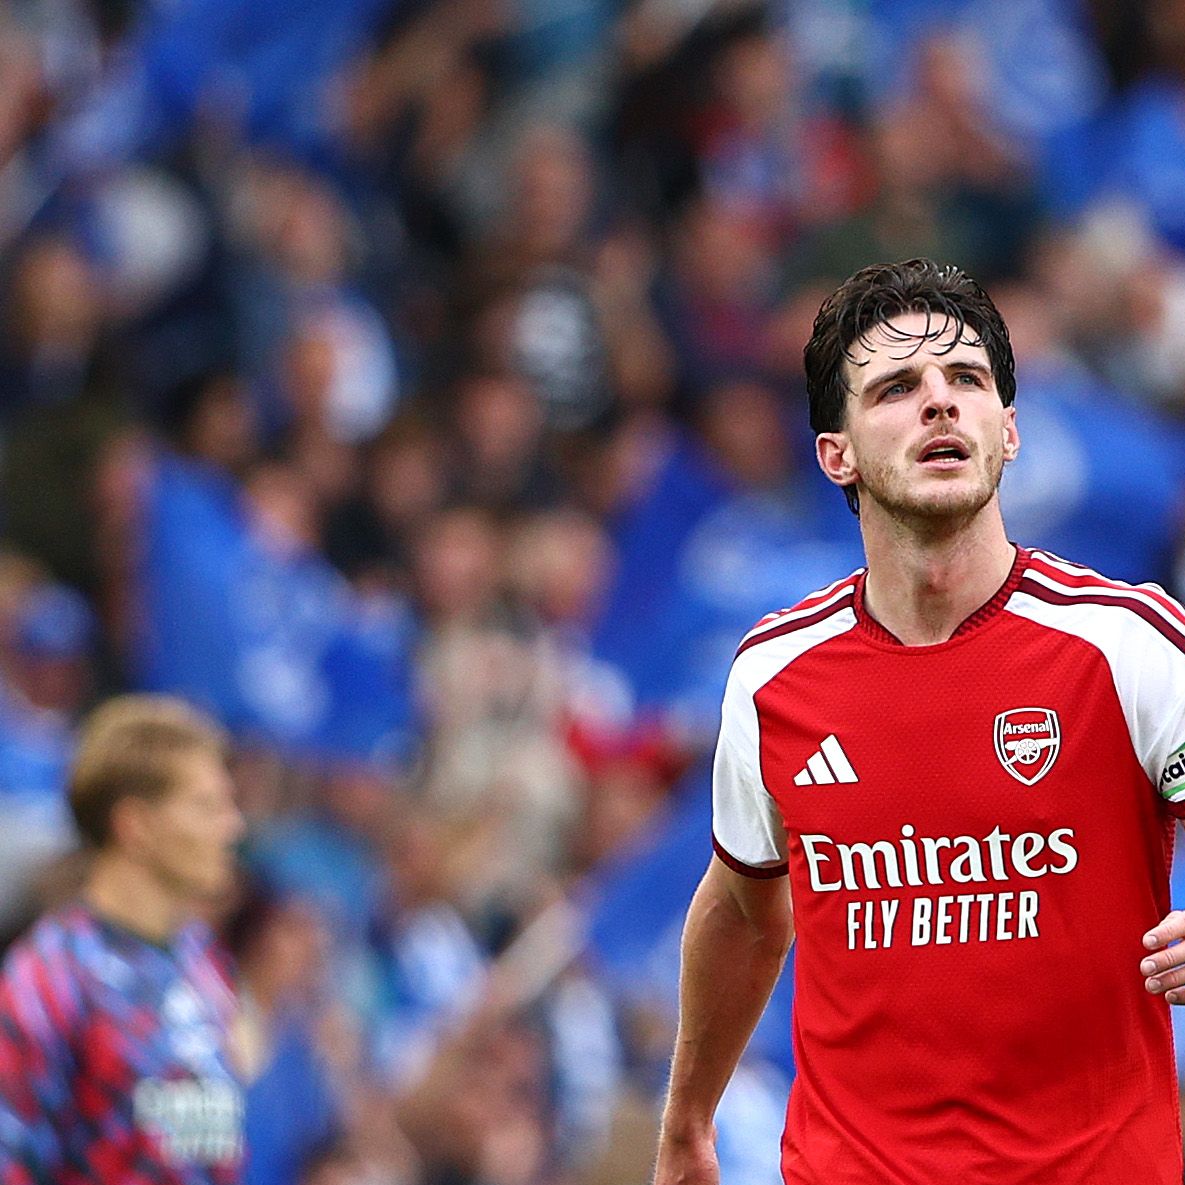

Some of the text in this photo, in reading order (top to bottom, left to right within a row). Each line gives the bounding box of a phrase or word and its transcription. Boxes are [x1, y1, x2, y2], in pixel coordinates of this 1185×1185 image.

[1002, 719, 1051, 736] Arsenal
[799, 823, 1079, 893] Emirates
[847, 889, 1040, 951] FLY BETTER
